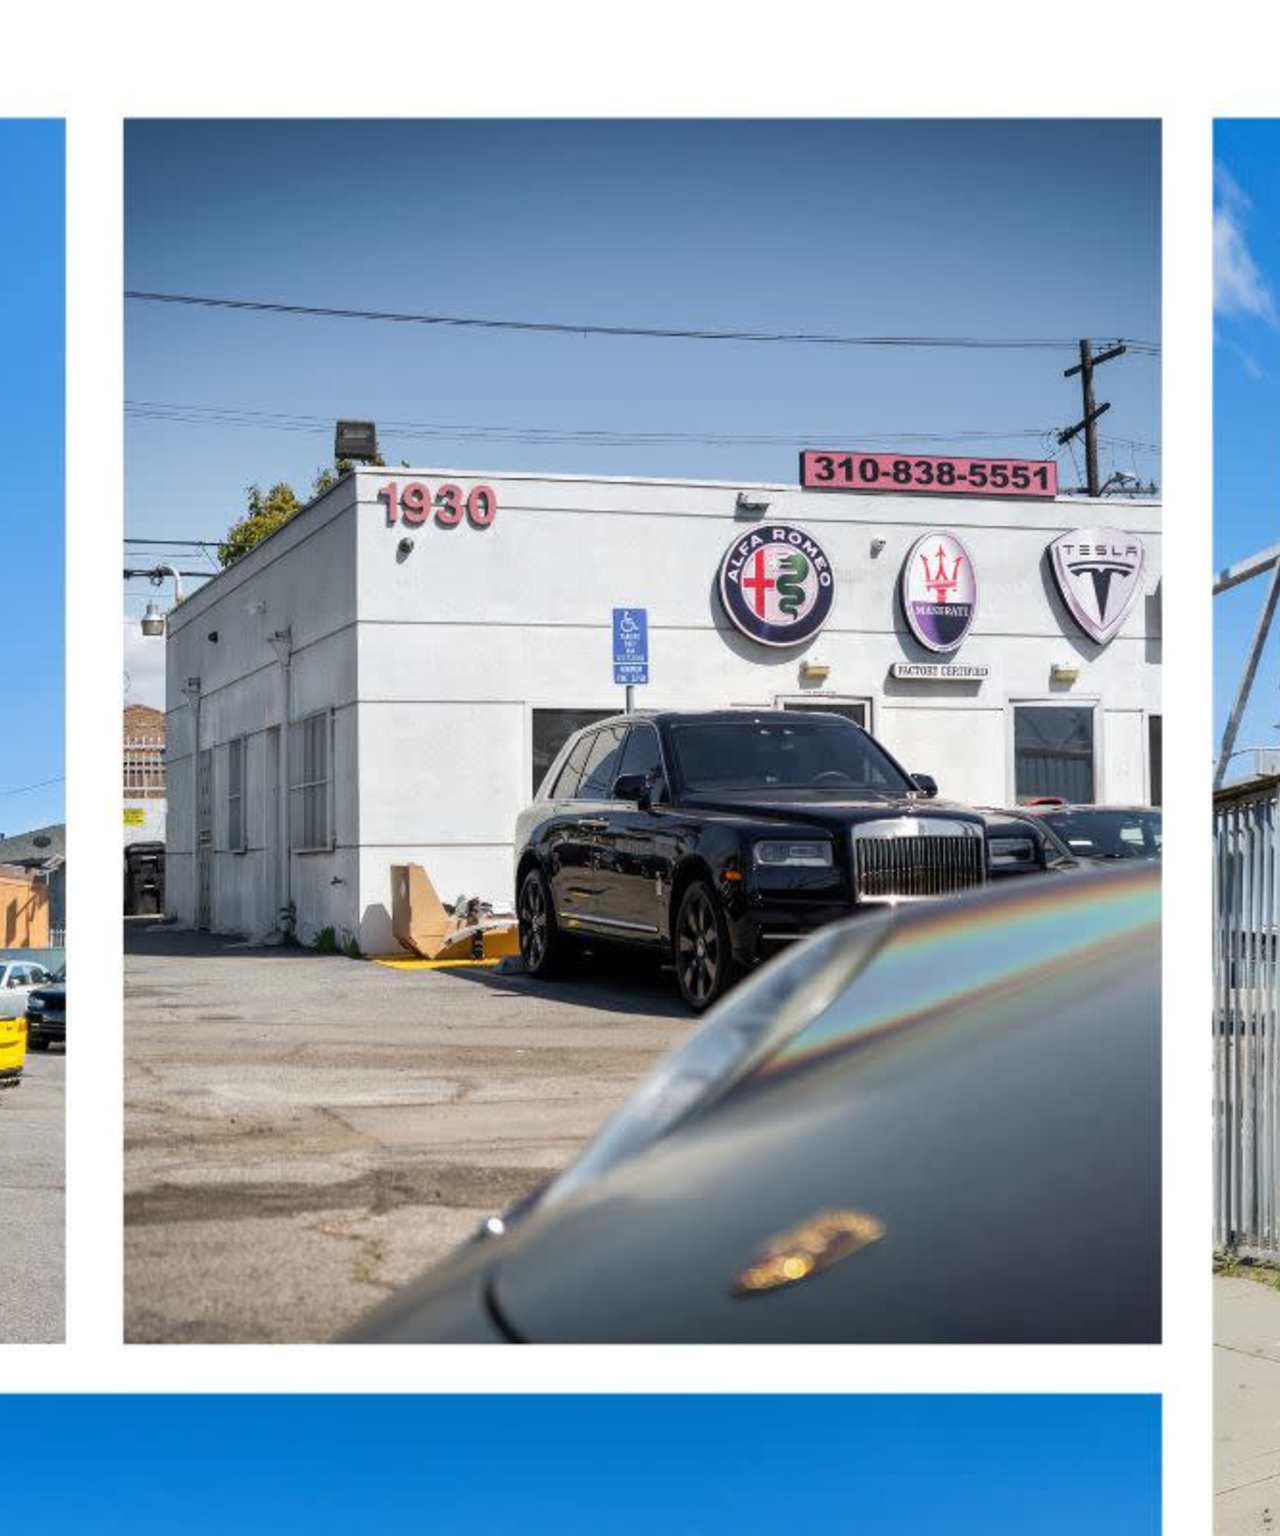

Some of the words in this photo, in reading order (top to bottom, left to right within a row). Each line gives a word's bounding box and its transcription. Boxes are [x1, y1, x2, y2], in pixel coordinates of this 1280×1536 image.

[814, 457, 1049, 490] 310-838-5551
[378, 482, 496, 526] 1930
[728, 534, 763, 583] ALFA
[773, 529, 831, 586] ROMEO
[1063, 545, 1137, 555] TESLA
